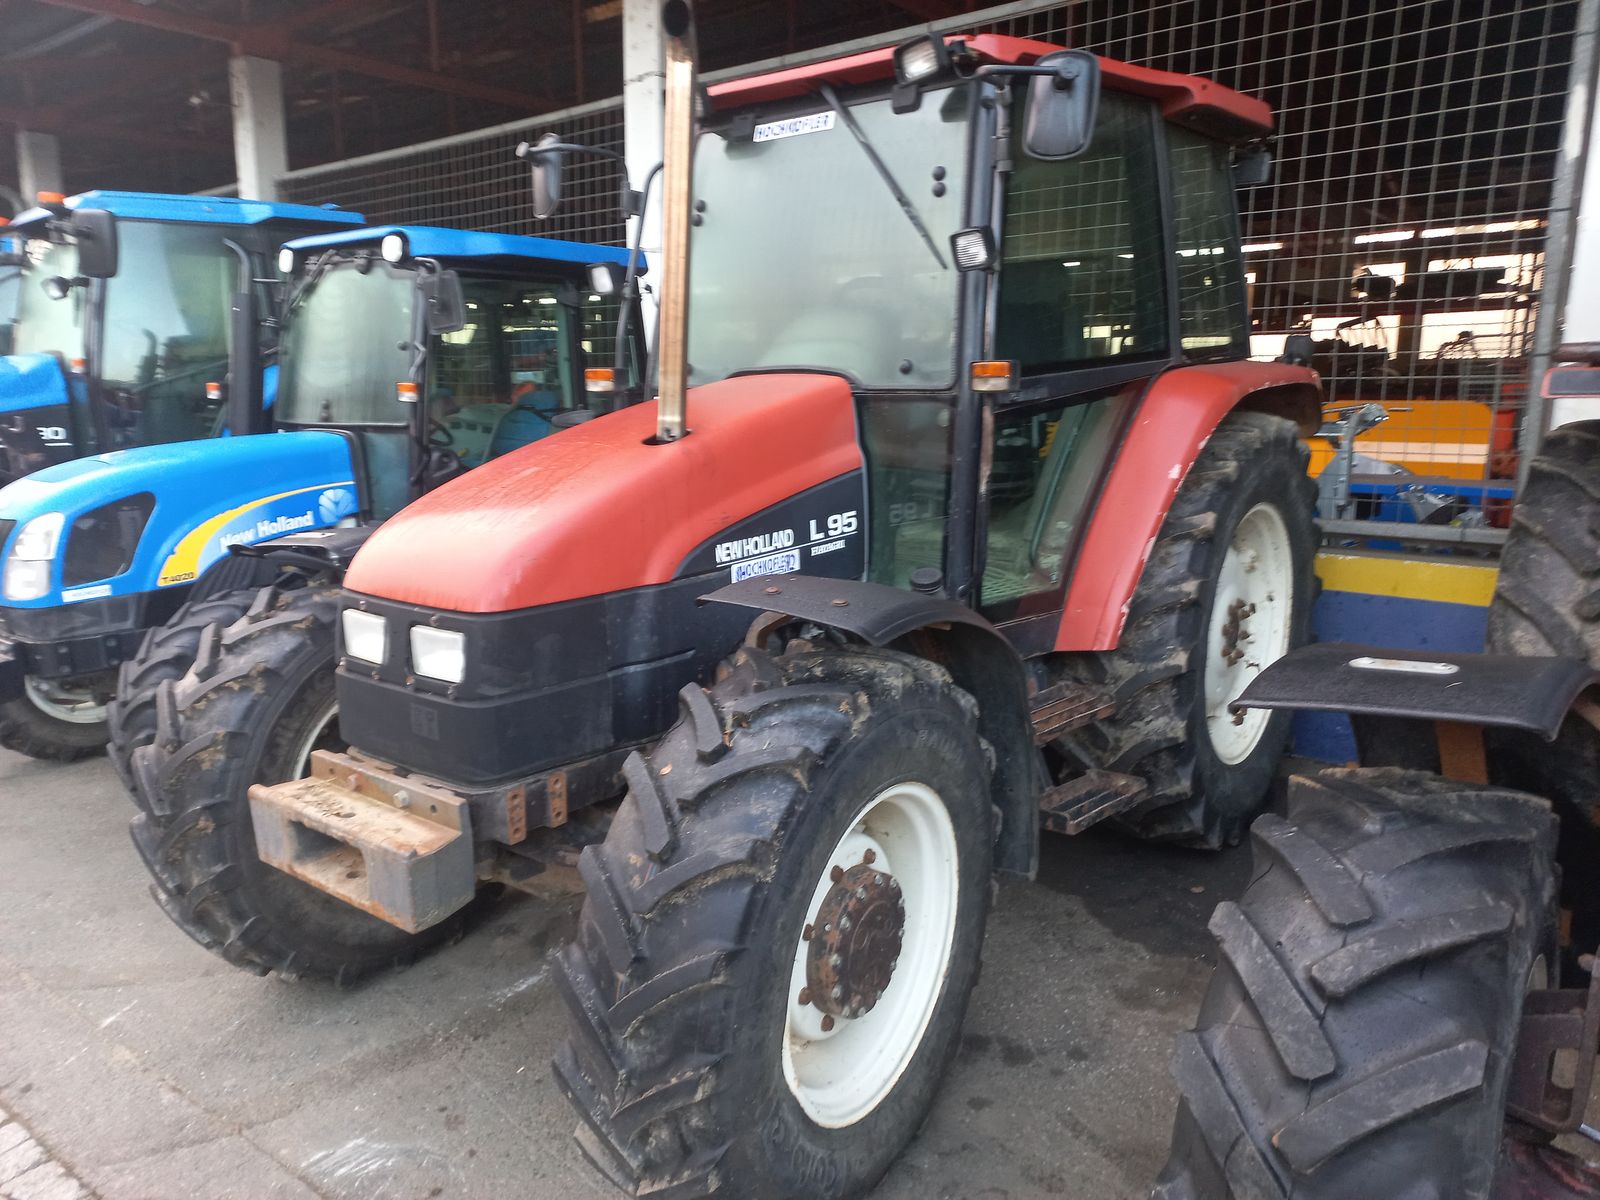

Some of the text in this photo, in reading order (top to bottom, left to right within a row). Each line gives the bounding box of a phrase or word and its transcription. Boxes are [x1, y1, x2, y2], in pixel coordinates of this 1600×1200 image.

[219, 510, 315, 552] New Holland
[809, 510, 858, 541] L 95
[714, 537, 744, 564] NEW
[743, 528, 795, 557] HOLLAND
